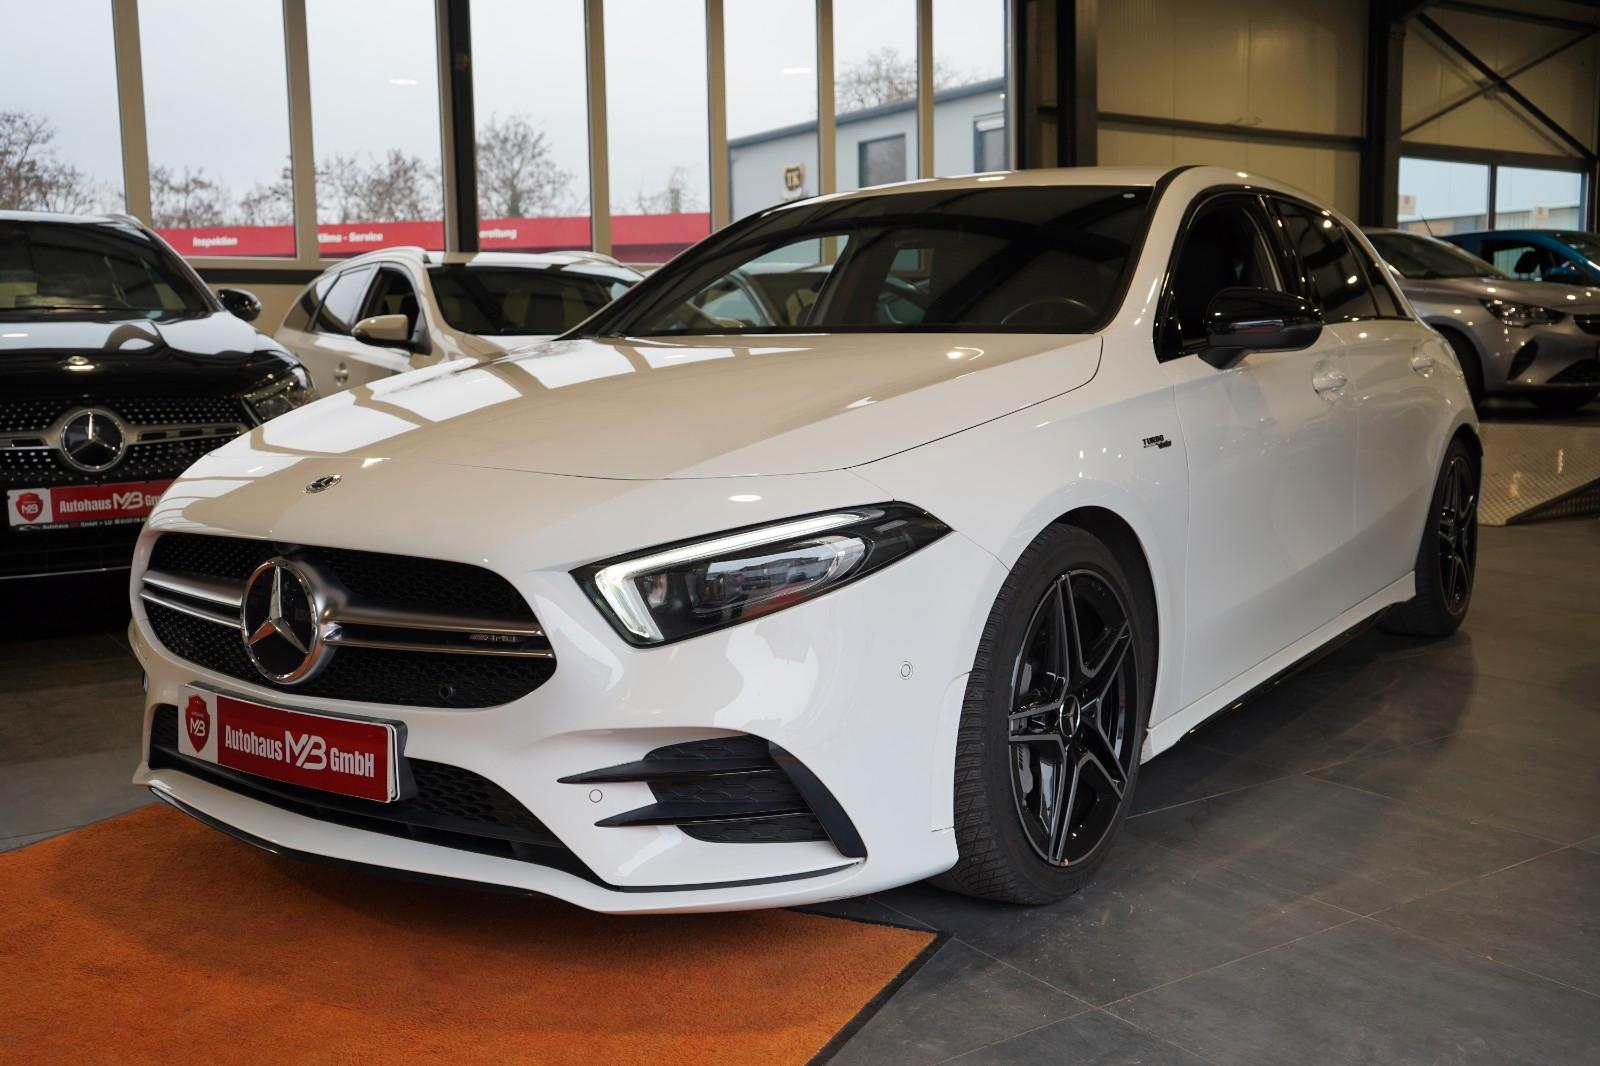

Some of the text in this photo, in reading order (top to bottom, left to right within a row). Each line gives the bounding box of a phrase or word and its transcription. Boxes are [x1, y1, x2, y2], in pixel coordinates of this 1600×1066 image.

[349, 231, 384, 243] Service
[479, 228, 518, 240] ereitung
[192, 235, 238, 248] Inspektion
[59, 498, 112, 513] Autohaus
[144, 494, 161, 507] Gm
[225, 725, 283, 761] Autohaus
[330, 747, 374, 778] GmbH
